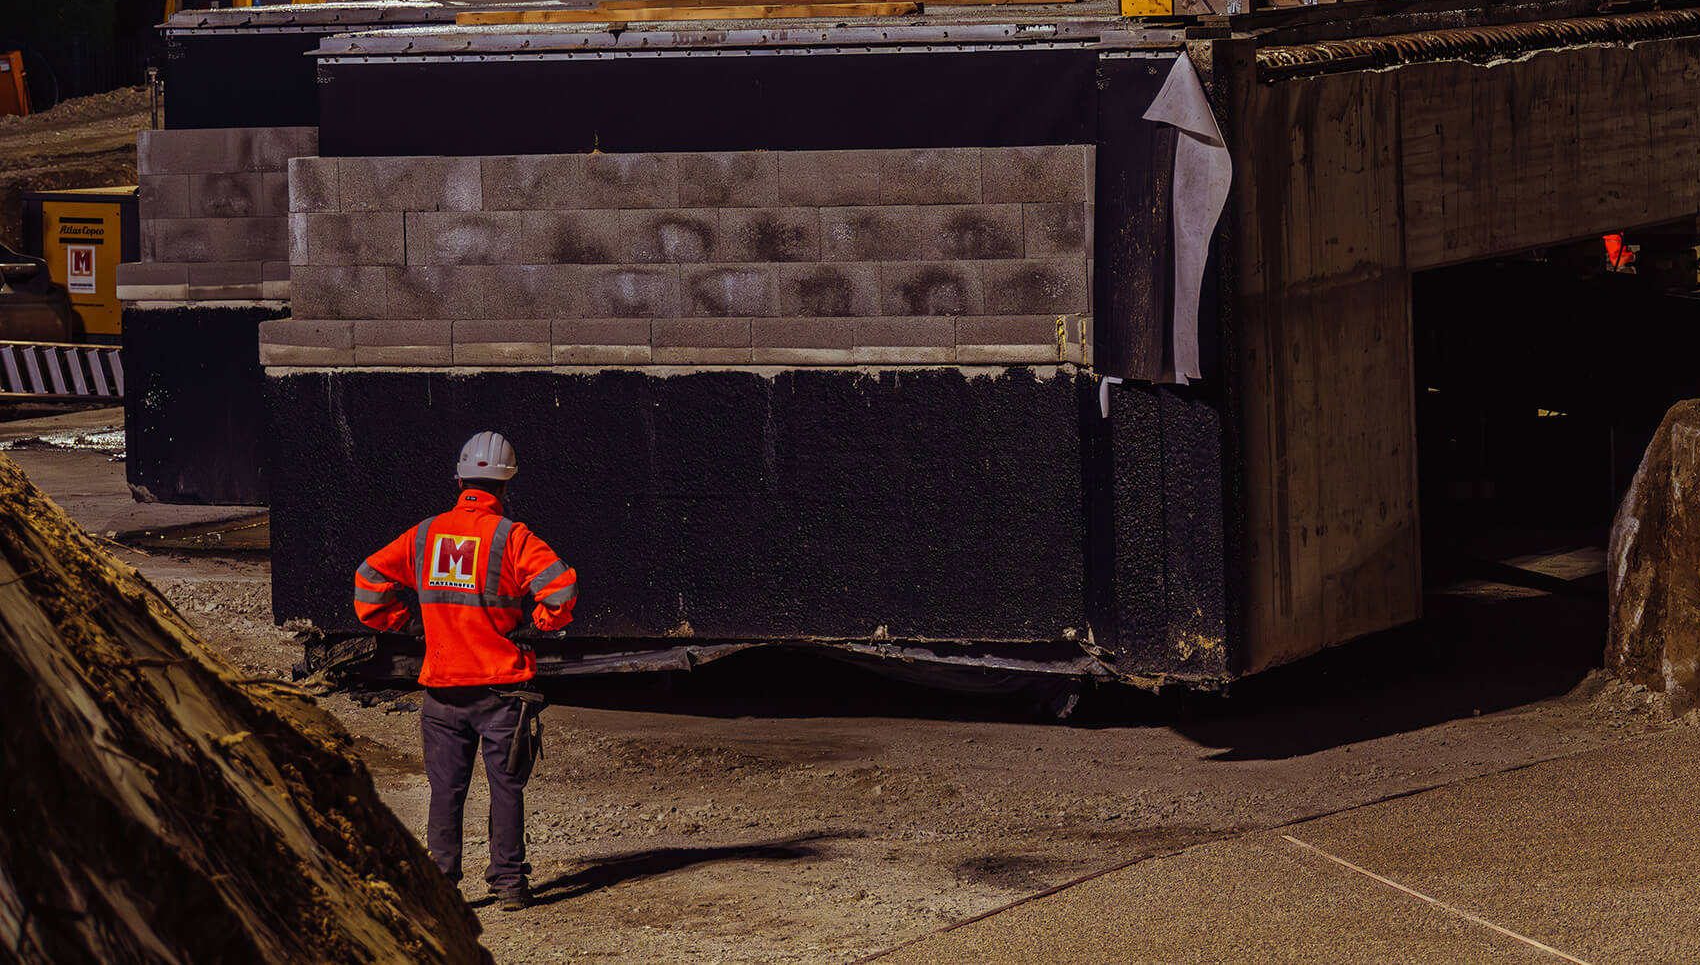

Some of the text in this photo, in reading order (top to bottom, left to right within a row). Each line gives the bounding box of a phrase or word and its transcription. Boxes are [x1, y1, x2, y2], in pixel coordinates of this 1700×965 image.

[60, 225, 104, 236] Atlas Copco
[433, 537, 476, 580] M
